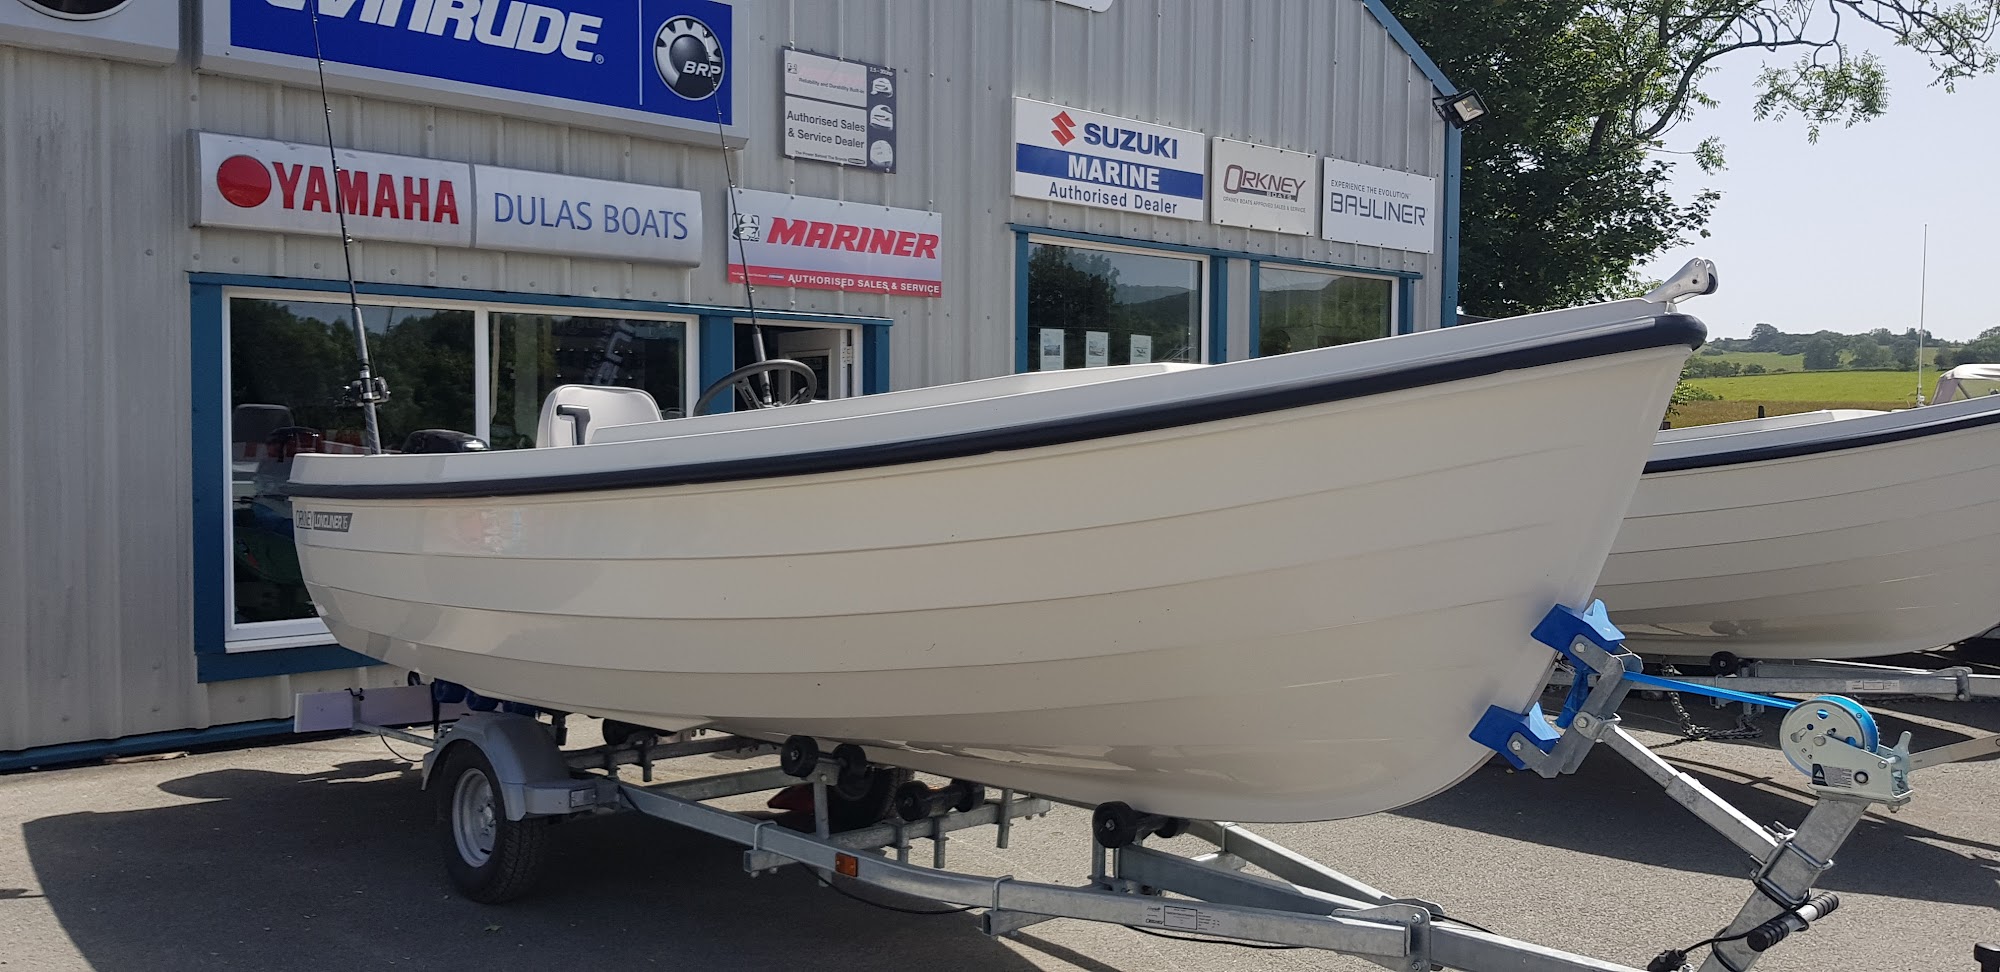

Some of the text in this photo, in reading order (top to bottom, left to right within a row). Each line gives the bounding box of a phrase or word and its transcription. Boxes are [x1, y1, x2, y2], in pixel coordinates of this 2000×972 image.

[682, 60, 722, 78] BRP
[786, 110, 866, 133] Authorised Sales
[788, 127, 865, 149] & Service Dealer
[1083, 122, 1178, 160] SUZUKI
[1068, 154, 1160, 191] MARINE
[1223, 164, 1306, 202] ORKNEY
[272, 161, 460, 225] YAMAHA
[1048, 181, 1178, 214] Authorised Dealer
[1331, 180, 1410, 200] EXPERIENCE THE EVOLUTION
[494, 192, 688, 240] DULAS BOATS
[1331, 192, 1426, 226] BAYLINER
[766, 217, 939, 259] MARINER
[788, 274, 855, 287] AUTHORISED
[857, 279, 888, 291] SALES
[891, 282, 898, 290] &
[900, 283, 940, 294] SERVICE
